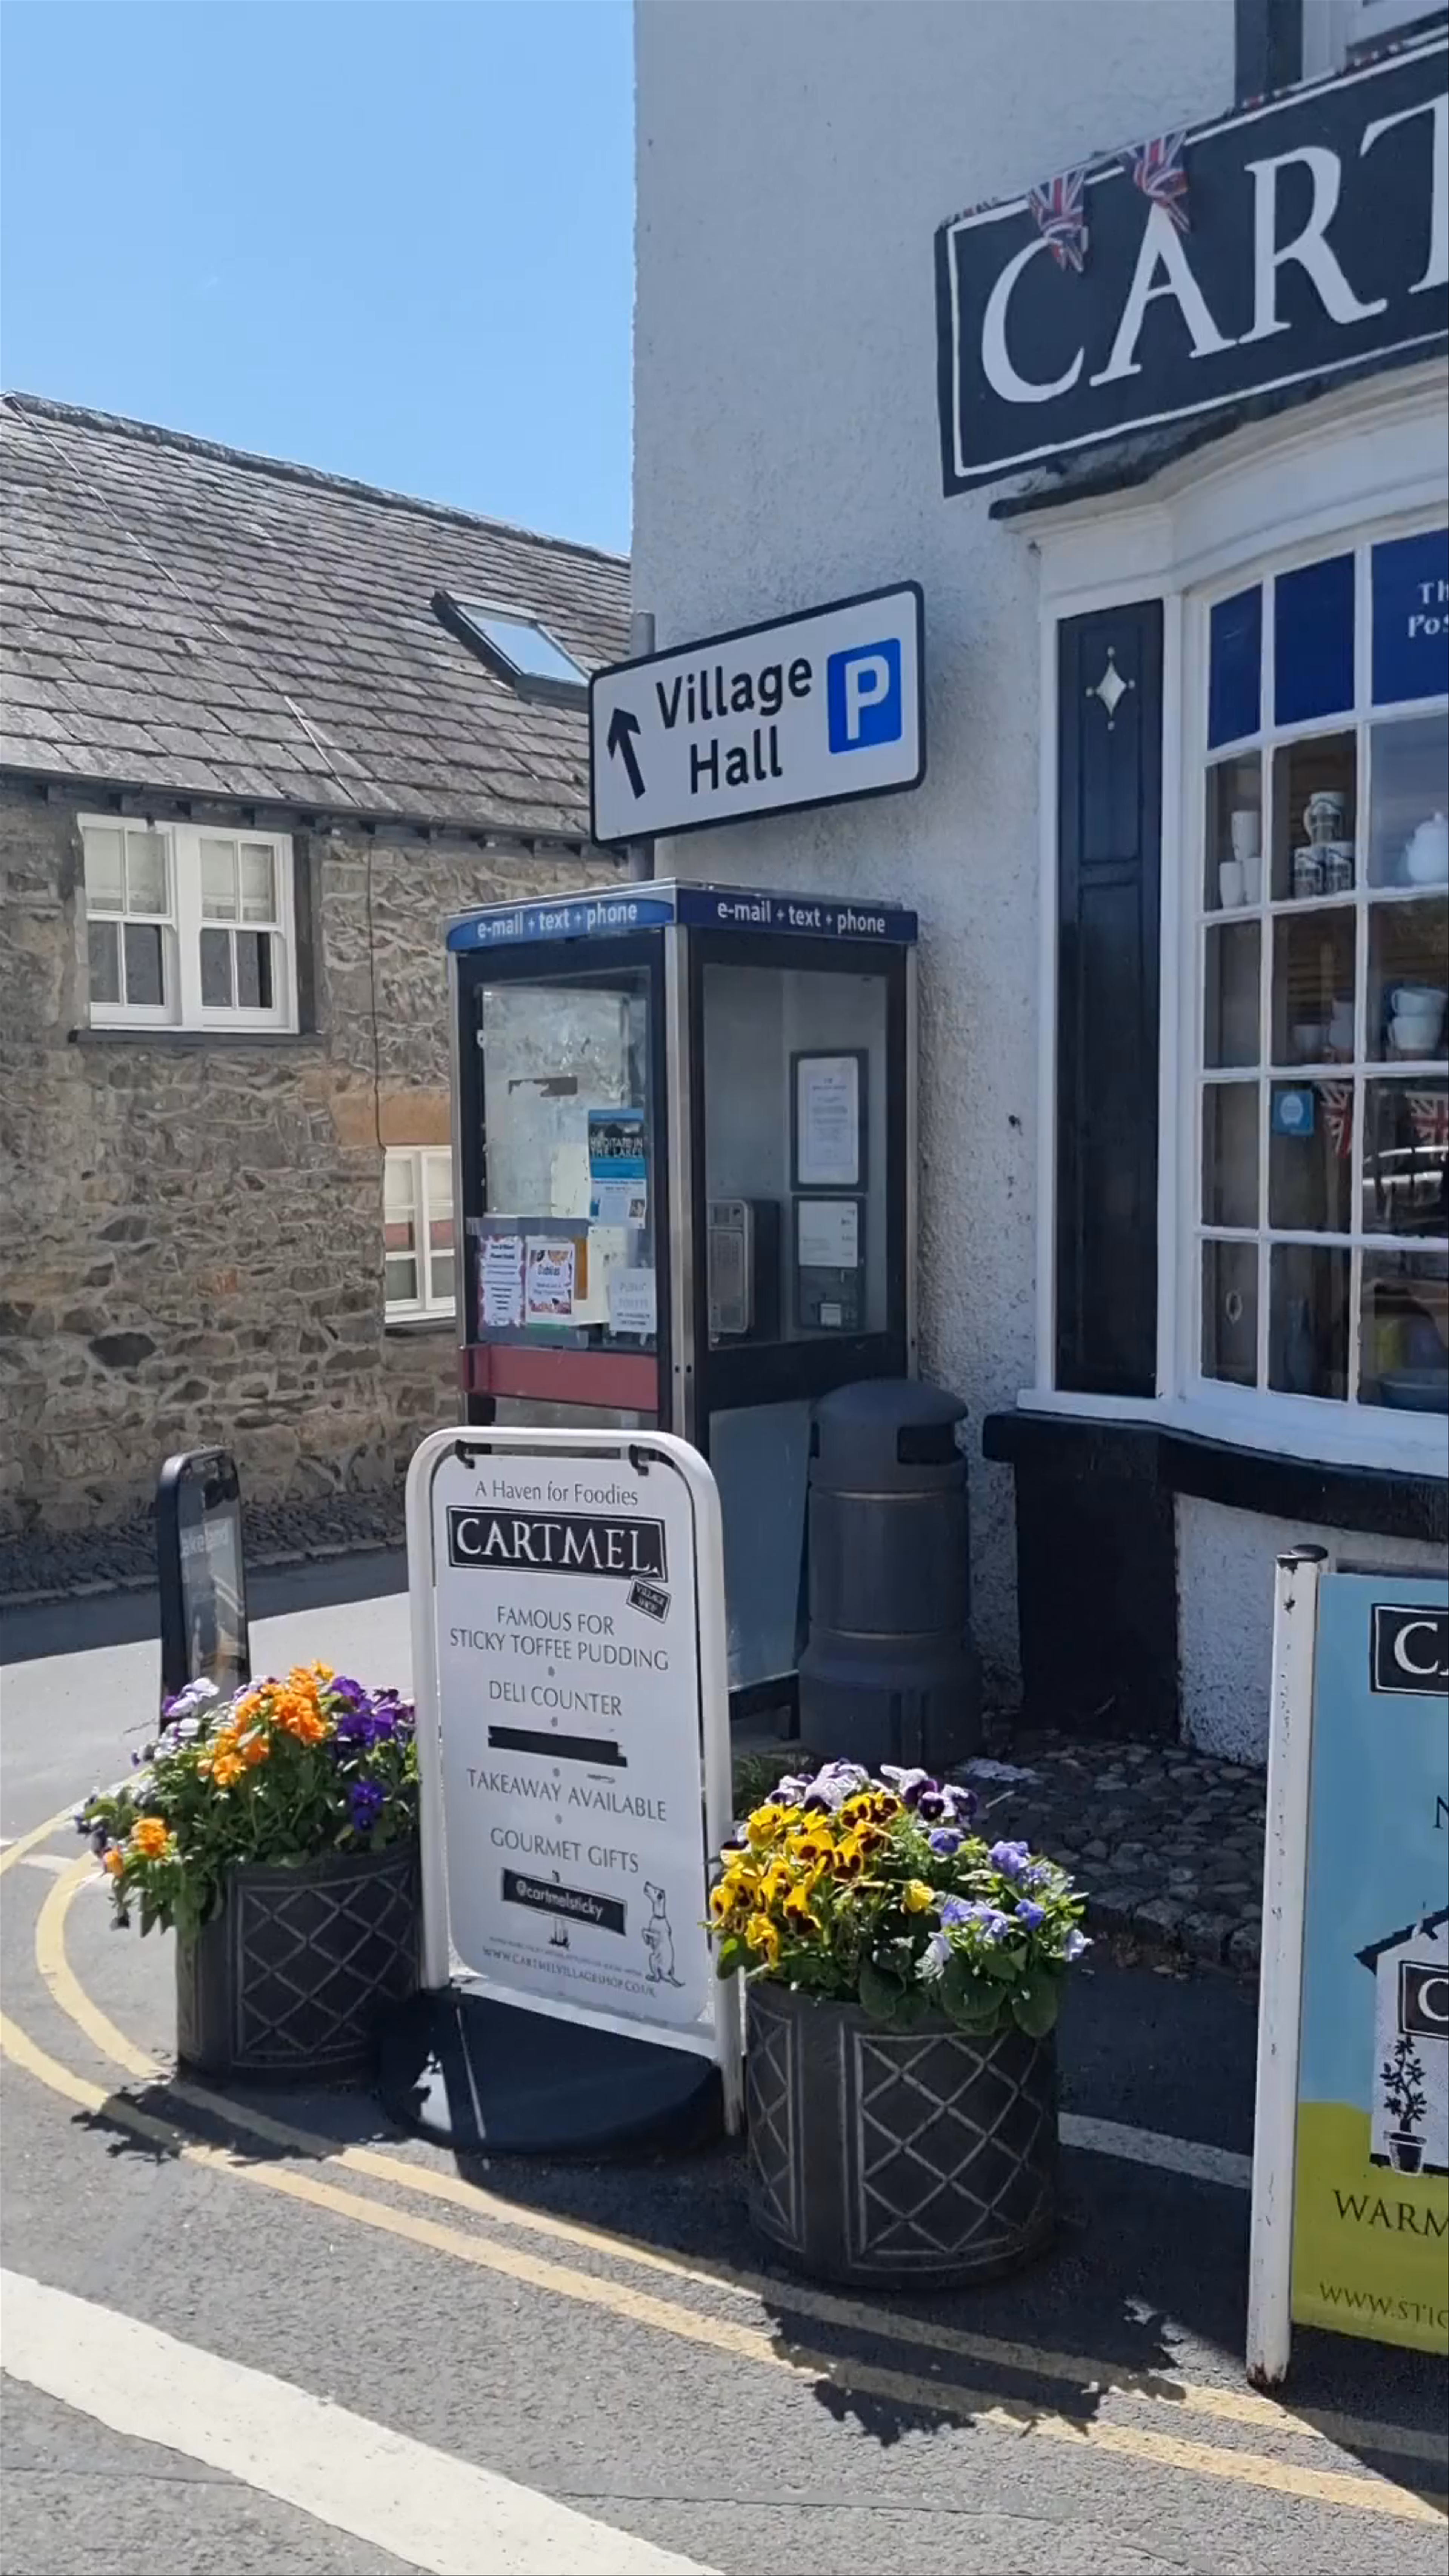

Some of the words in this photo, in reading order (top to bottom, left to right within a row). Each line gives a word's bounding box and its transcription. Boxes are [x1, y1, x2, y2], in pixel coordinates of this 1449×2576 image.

[656, 658, 812, 729] Village
[845, 655, 890, 741] P
[690, 725, 783, 794] Hall
[478, 912, 523, 938] e-mail
[539, 909, 570, 930] text
[587, 902, 637, 930] phone
[717, 901, 771, 923] e-mail
[789, 906, 820, 927] text
[838, 909, 885, 934] phone
[475, 1481, 487, 1498] A
[492, 1480, 541, 1501] Haven
[547, 1481, 569, 1502] for
[574, 1483, 638, 1506] Foodies
[457, 1518, 653, 1572] CARTMEL
[498, 1606, 572, 1632] FAMOUS
[578, 1613, 614, 1636] FOR
[450, 1628, 506, 1653] STICKY
[511, 1634, 571, 1659] TOFFEE
[578, 1642, 669, 1671] PUDDING
[490, 1681, 525, 1703] DELI
[531, 1686, 623, 1716] COUNTER
[467, 1768, 562, 1802] TAKEAWAY
[568, 1787, 667, 1821] AVAILABLE
[491, 1827, 581, 1861] GOURMET
[588, 1845, 639, 1873] GIFTS
